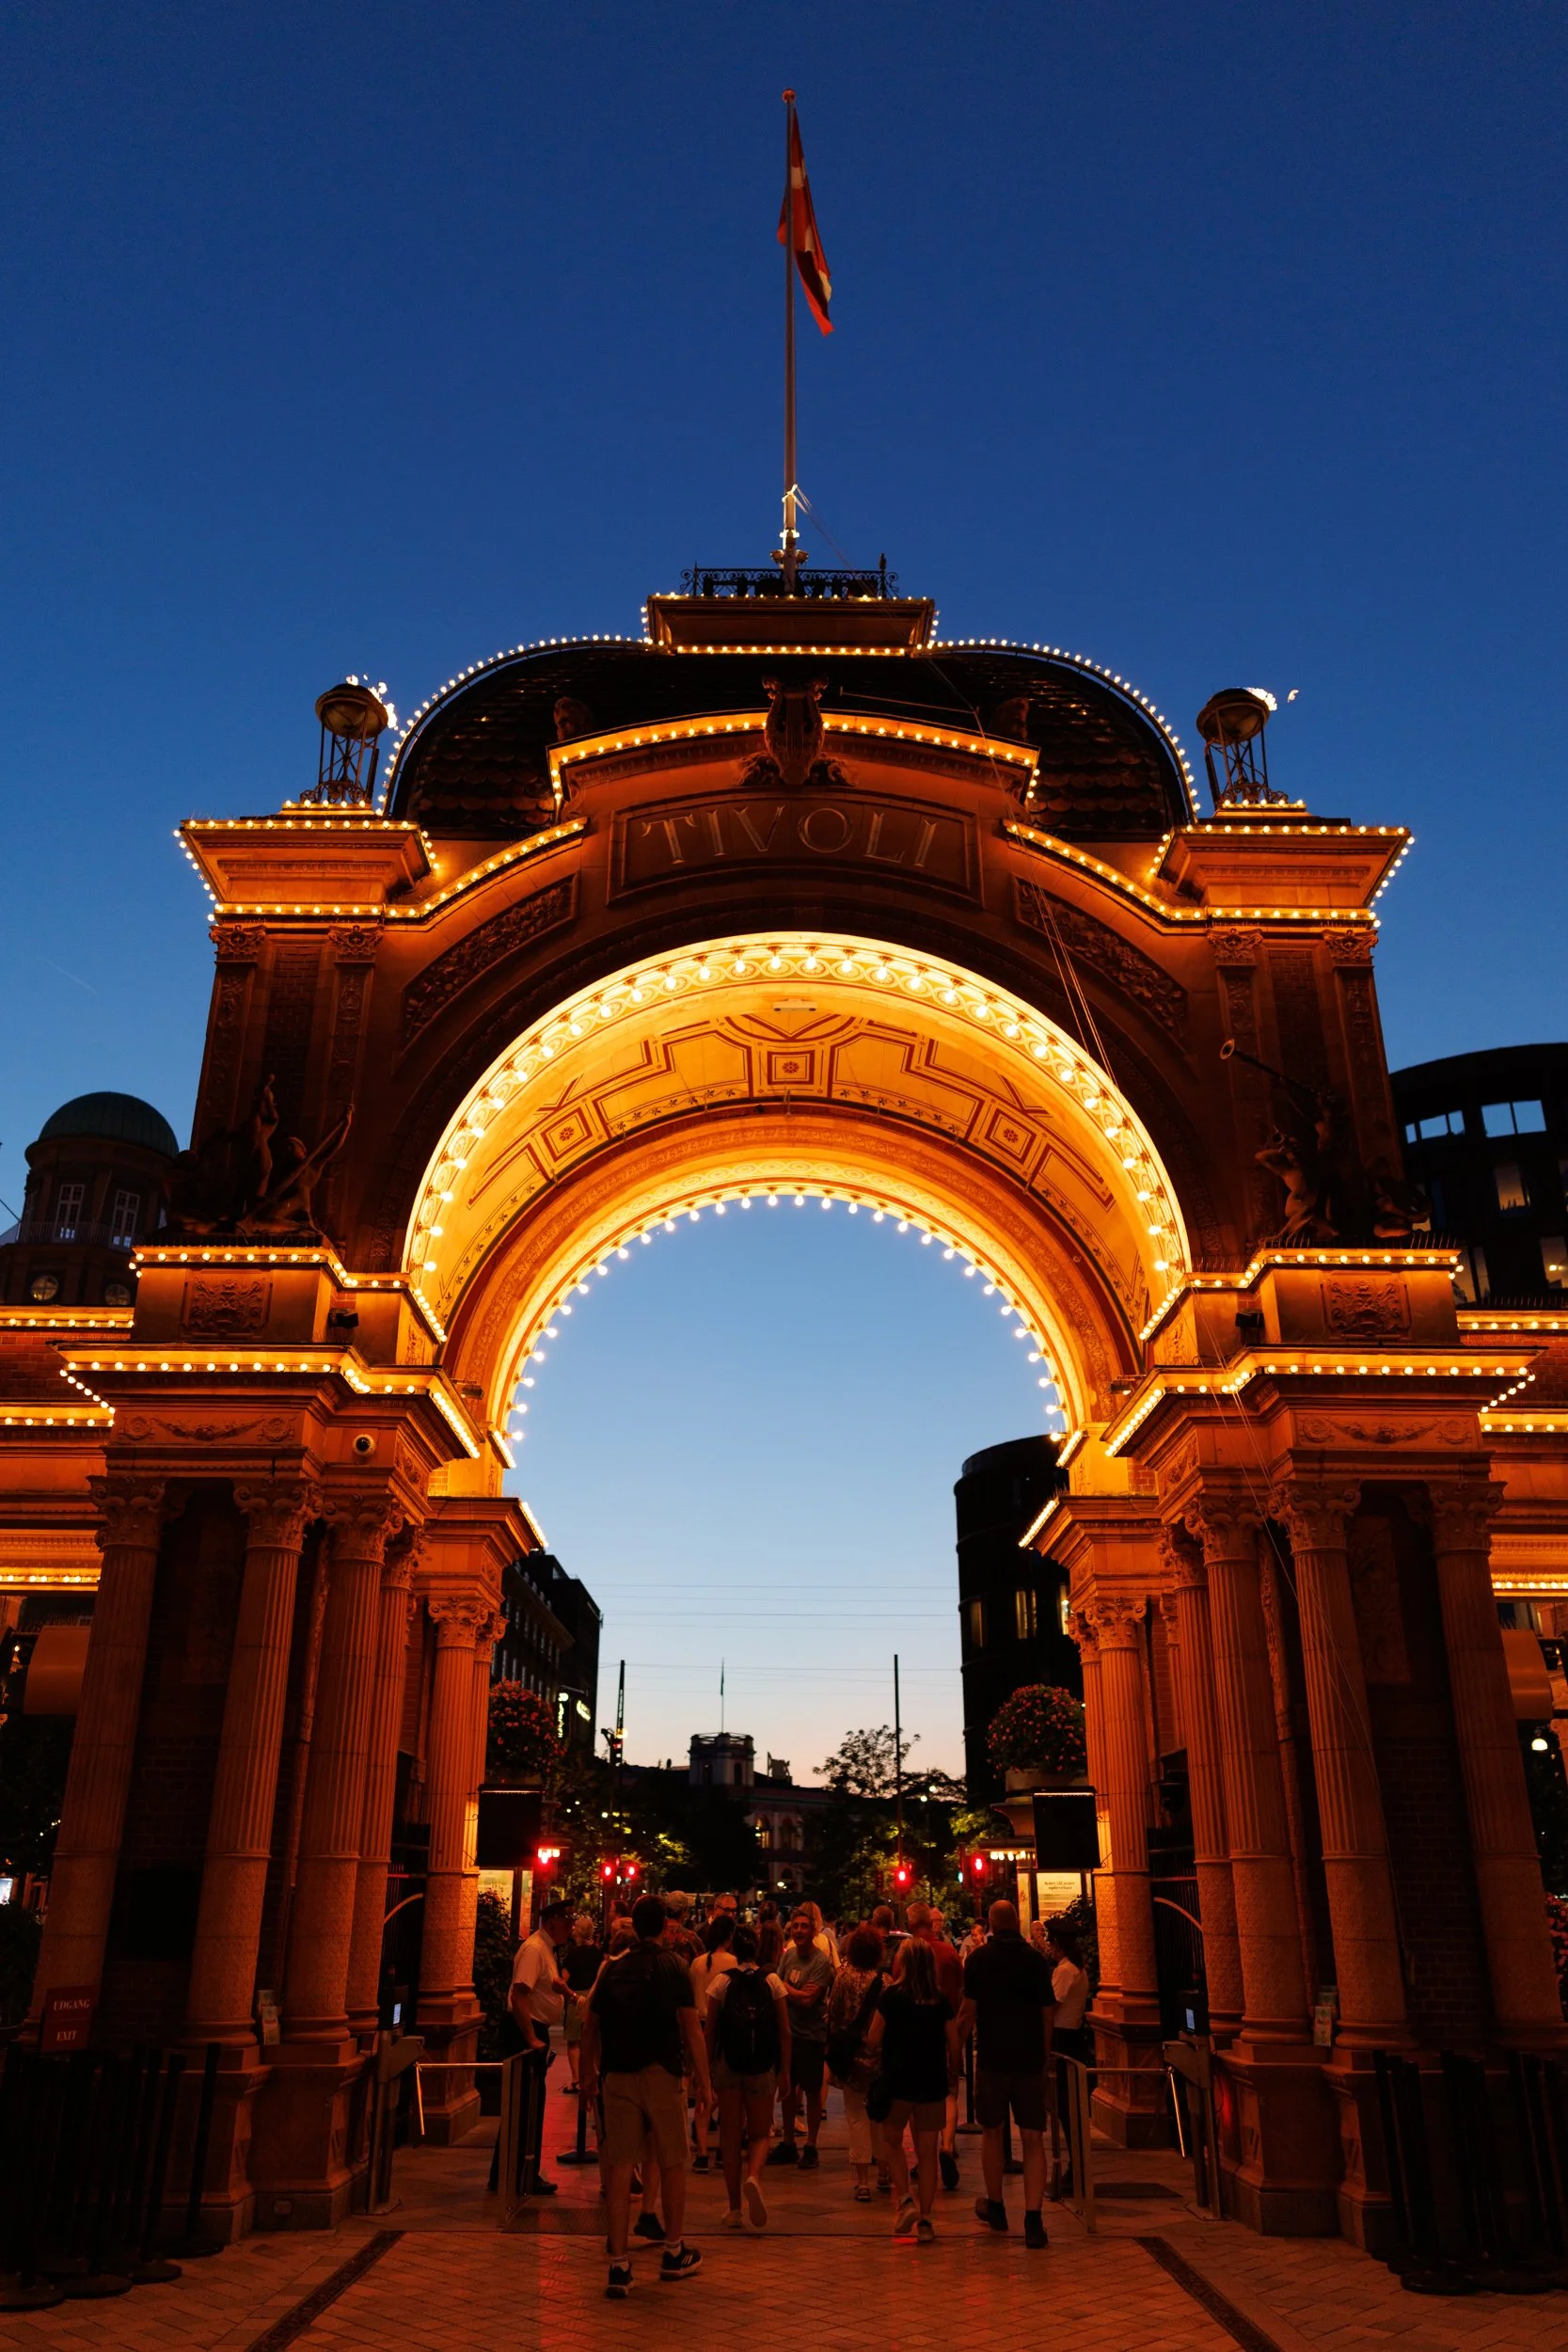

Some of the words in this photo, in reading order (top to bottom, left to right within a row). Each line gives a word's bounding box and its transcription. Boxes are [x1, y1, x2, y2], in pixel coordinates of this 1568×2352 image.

[641, 804, 938, 867] TIVOLI
[53, 1998, 90, 2011] UDGANG
[55, 2029, 78, 2042] EXIT
